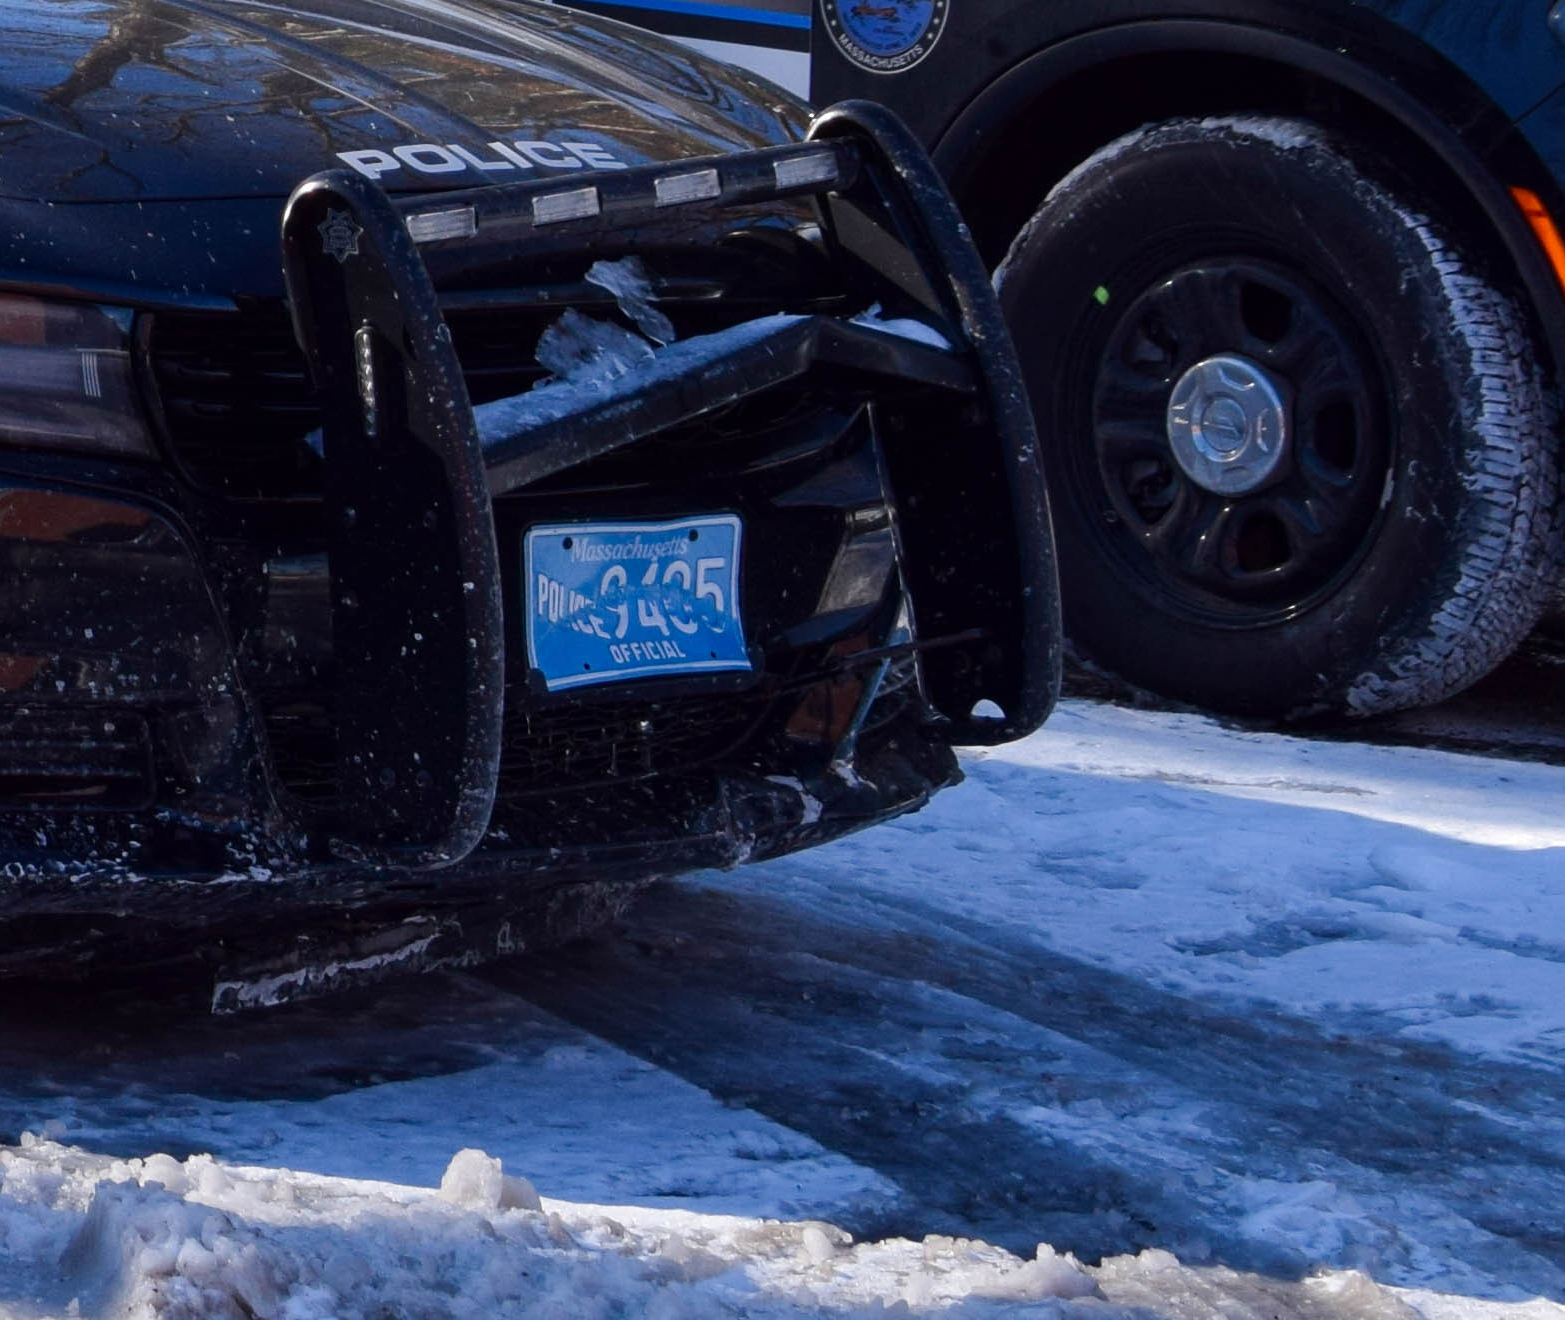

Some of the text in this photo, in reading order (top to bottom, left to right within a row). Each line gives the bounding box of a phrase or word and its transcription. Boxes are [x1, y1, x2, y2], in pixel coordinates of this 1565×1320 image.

[838, 33, 924, 69] MASSACHUSETTS
[336, 140, 629, 180] POLICE
[571, 534, 689, 563] Massachusetts
[609, 640, 687, 664] OFFICIAL
